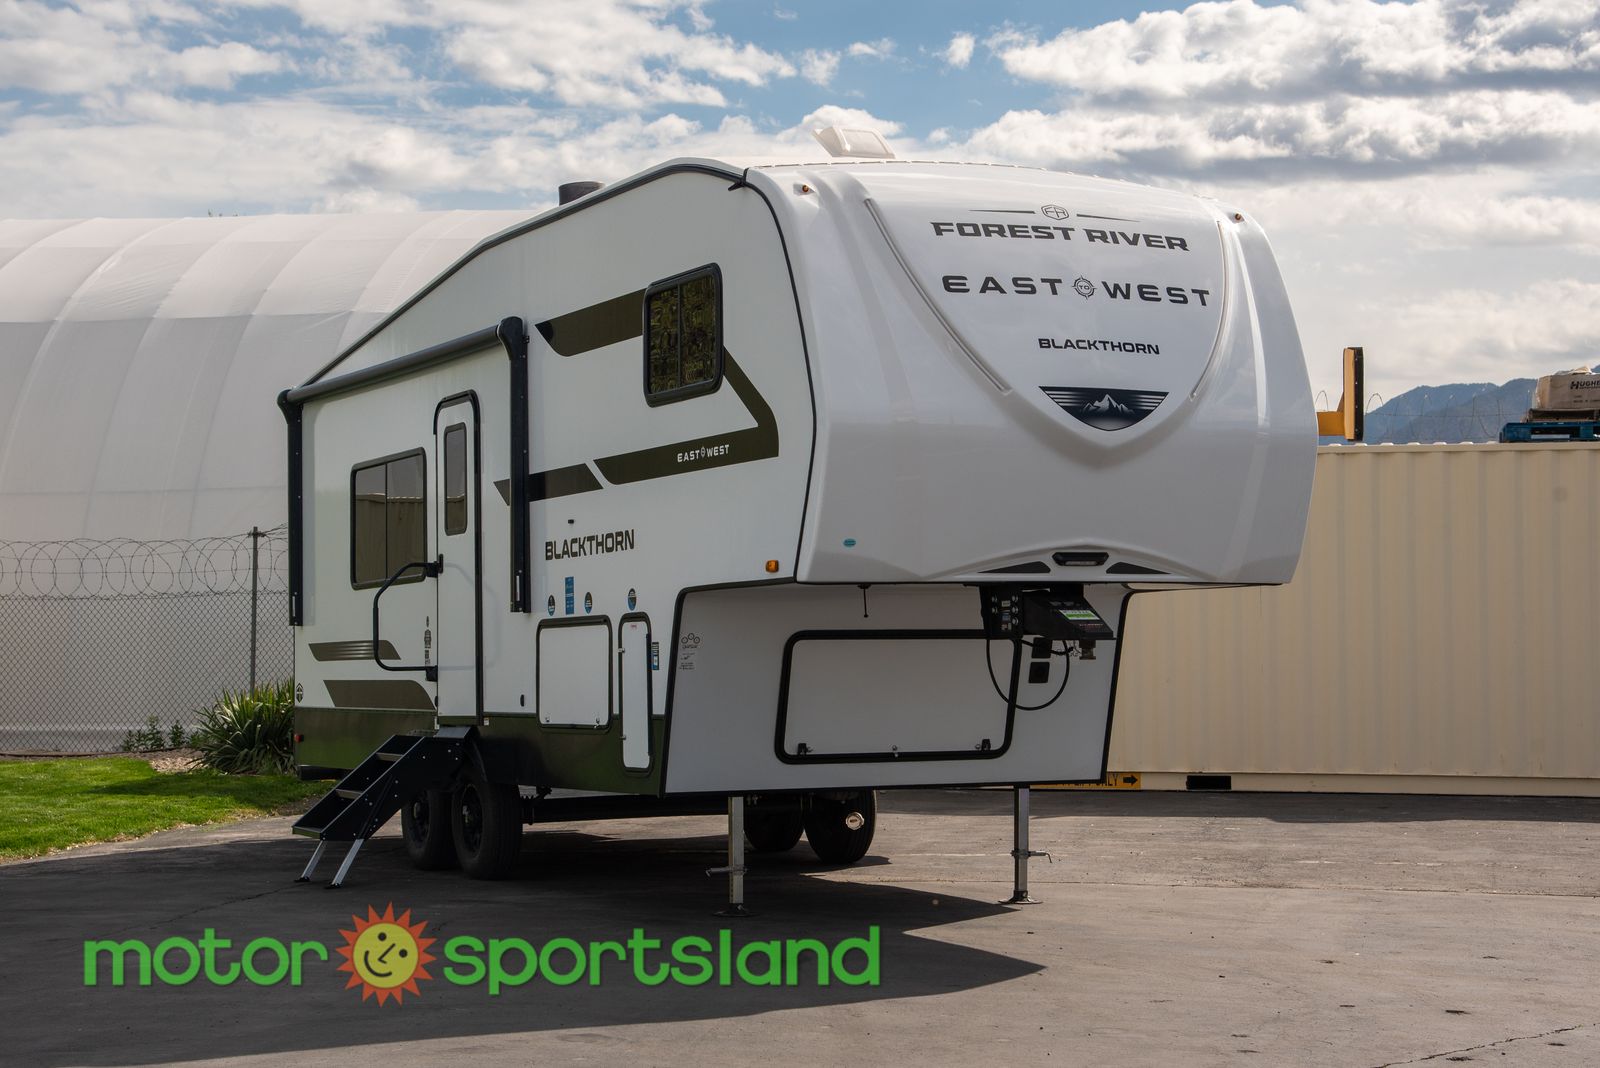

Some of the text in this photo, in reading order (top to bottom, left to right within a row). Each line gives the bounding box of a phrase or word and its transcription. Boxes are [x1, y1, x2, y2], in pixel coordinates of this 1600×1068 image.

[930, 221, 1190, 252] FOREST RIVER
[942, 275, 1063, 296] EAST
[1101, 280, 1210, 307] WEST
[1038, 338, 1160, 355] BLACKTHORN
[677, 449, 700, 463] EAST
[706, 444, 730, 458] WEST
[545, 529, 635, 561] BLACKTHORN
